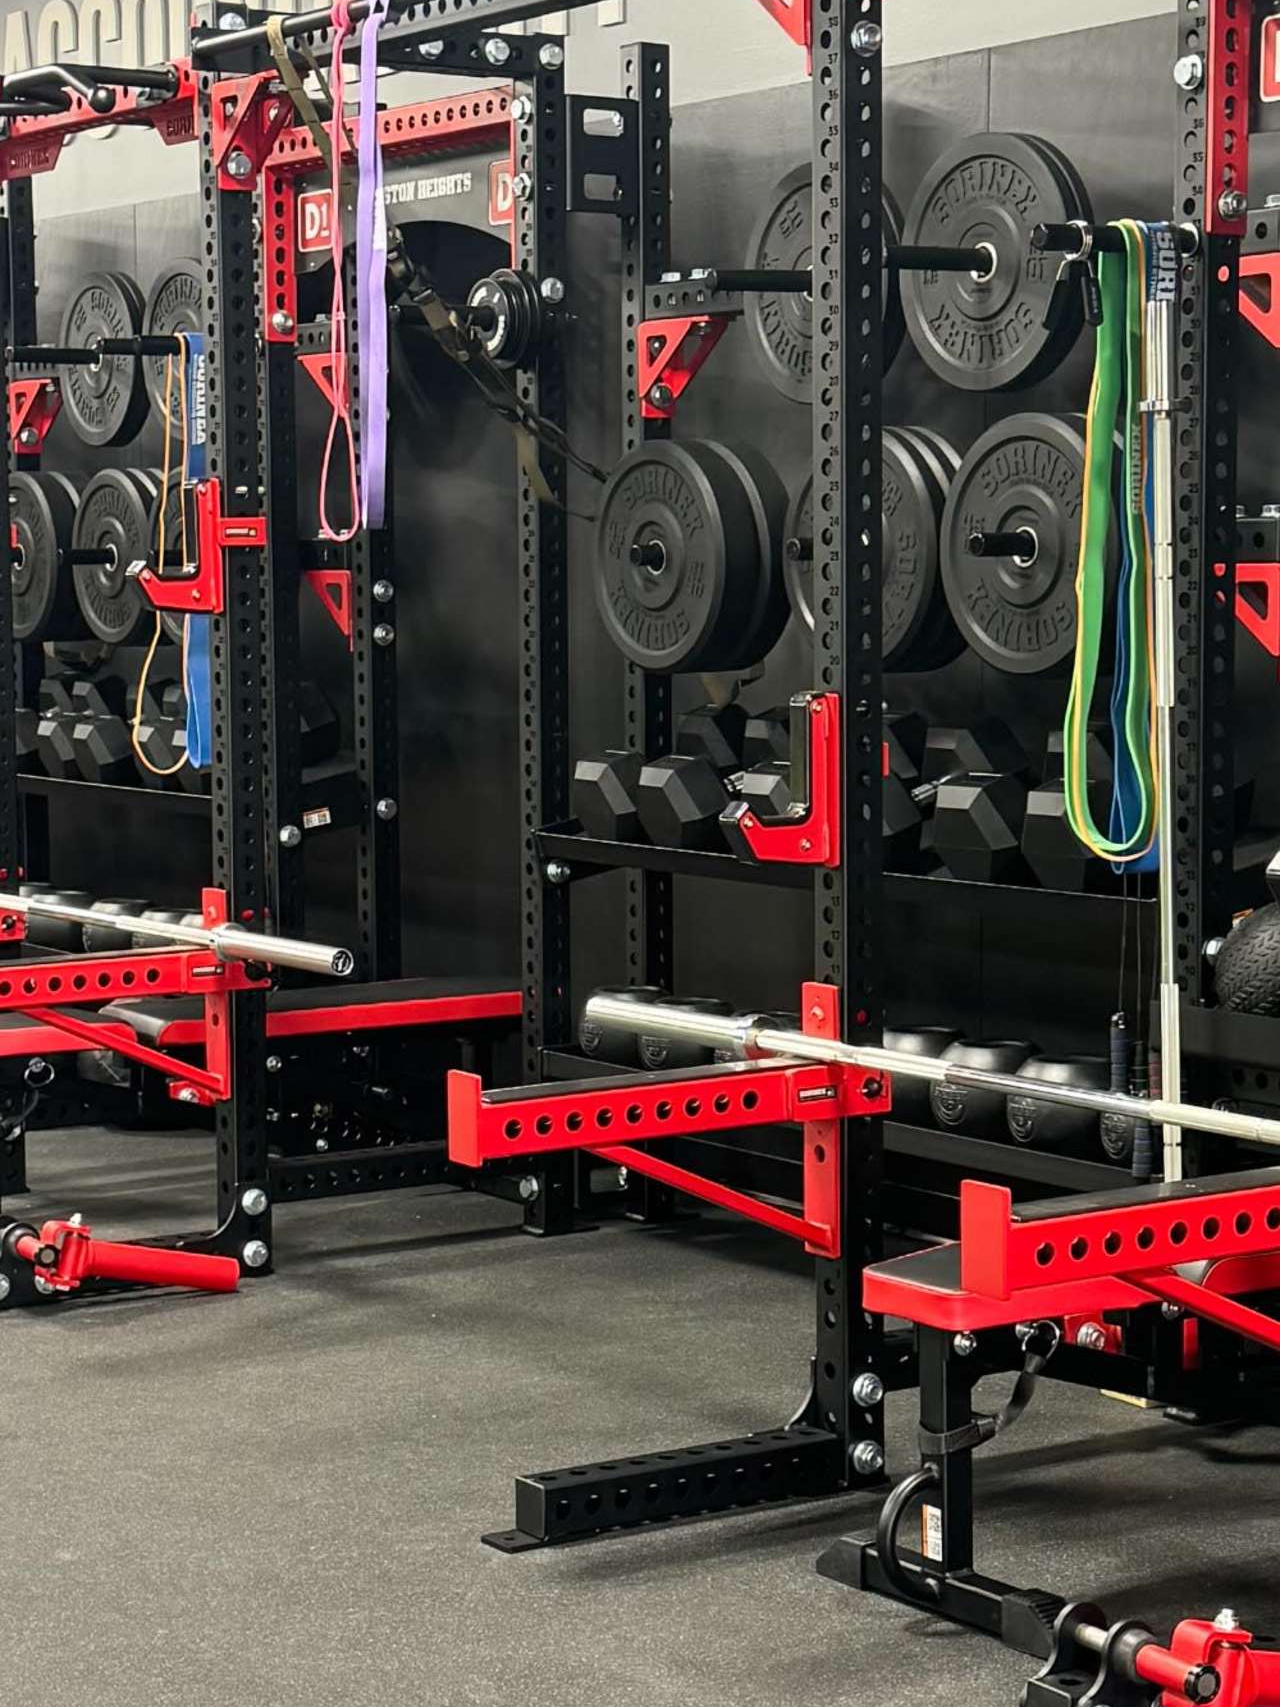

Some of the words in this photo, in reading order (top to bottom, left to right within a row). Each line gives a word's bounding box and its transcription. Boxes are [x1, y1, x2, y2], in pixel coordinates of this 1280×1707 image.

[829, 411, 841, 424] 27
[830, 516, 839, 529] 24
[830, 586, 839, 596] 22
[830, 621, 838, 633] 21
[827, 655, 842, 668] 20
